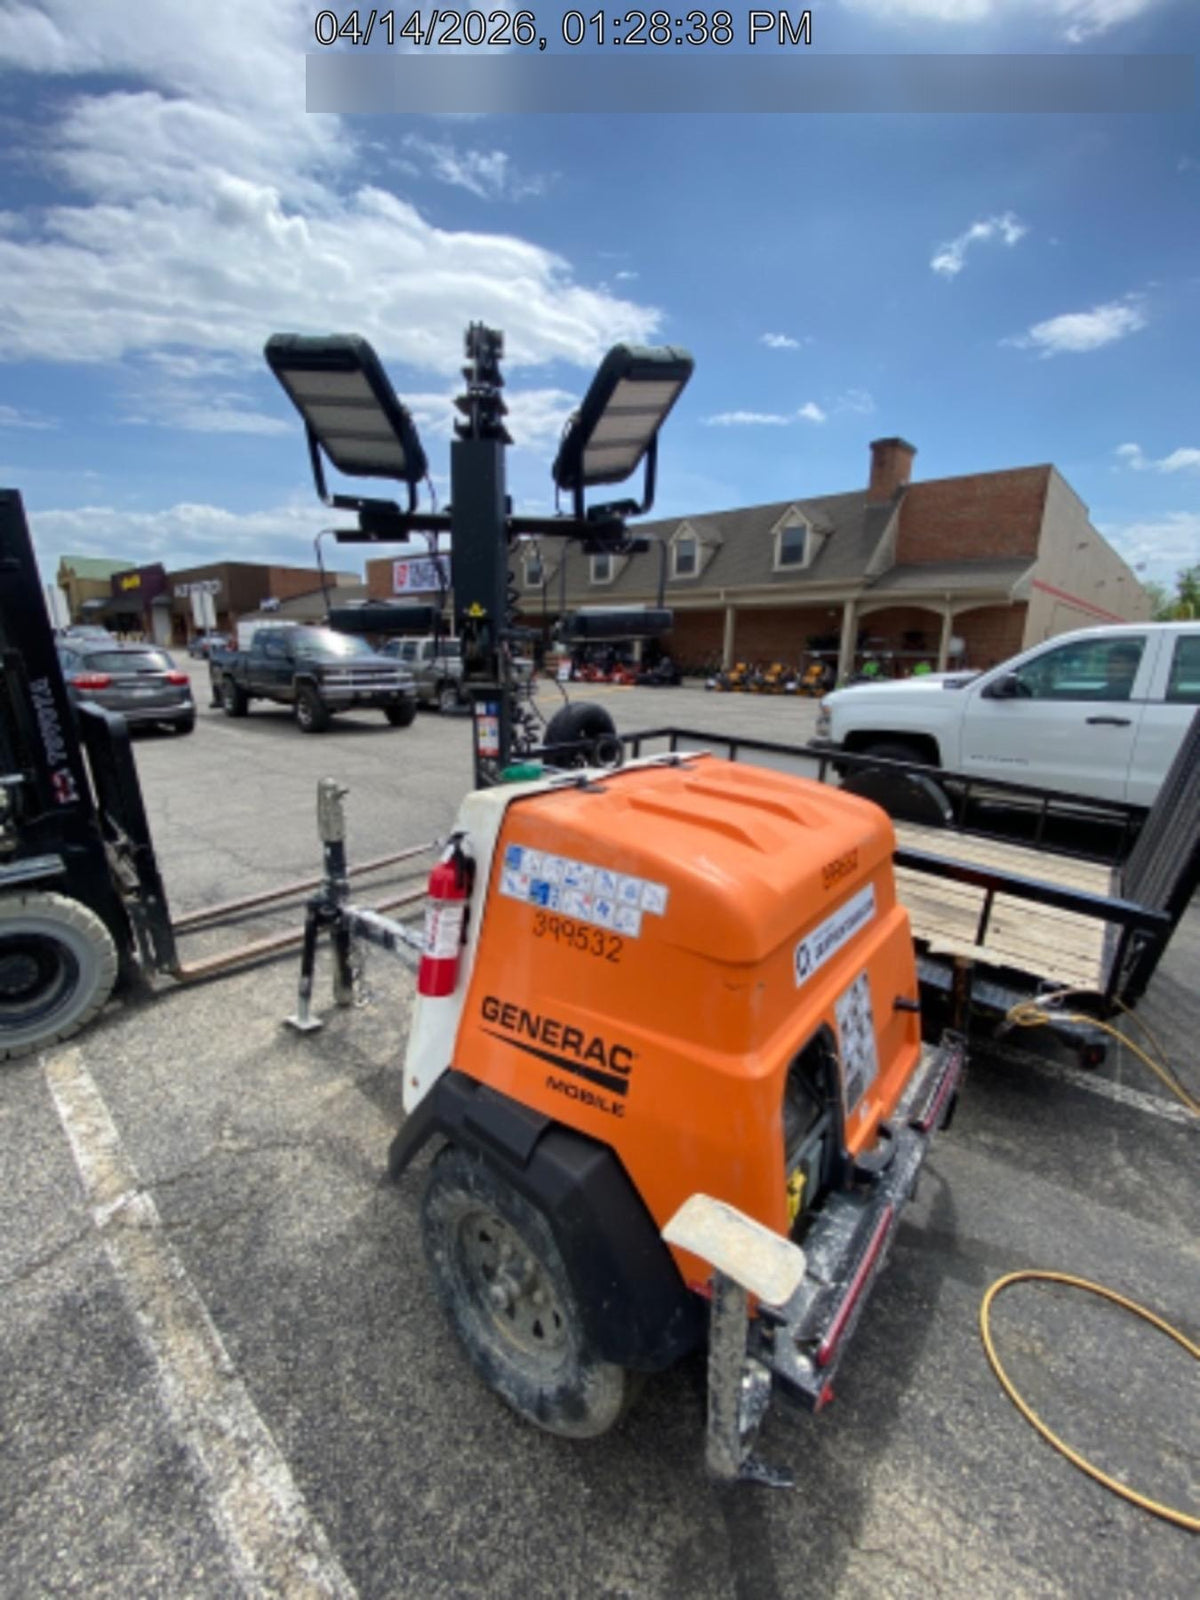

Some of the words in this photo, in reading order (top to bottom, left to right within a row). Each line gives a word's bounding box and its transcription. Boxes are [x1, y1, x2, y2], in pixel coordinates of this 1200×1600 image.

[532, 910, 623, 964] 399532
[482, 996, 633, 1075] GENERAC
[546, 1075, 625, 1118] MOBILE
